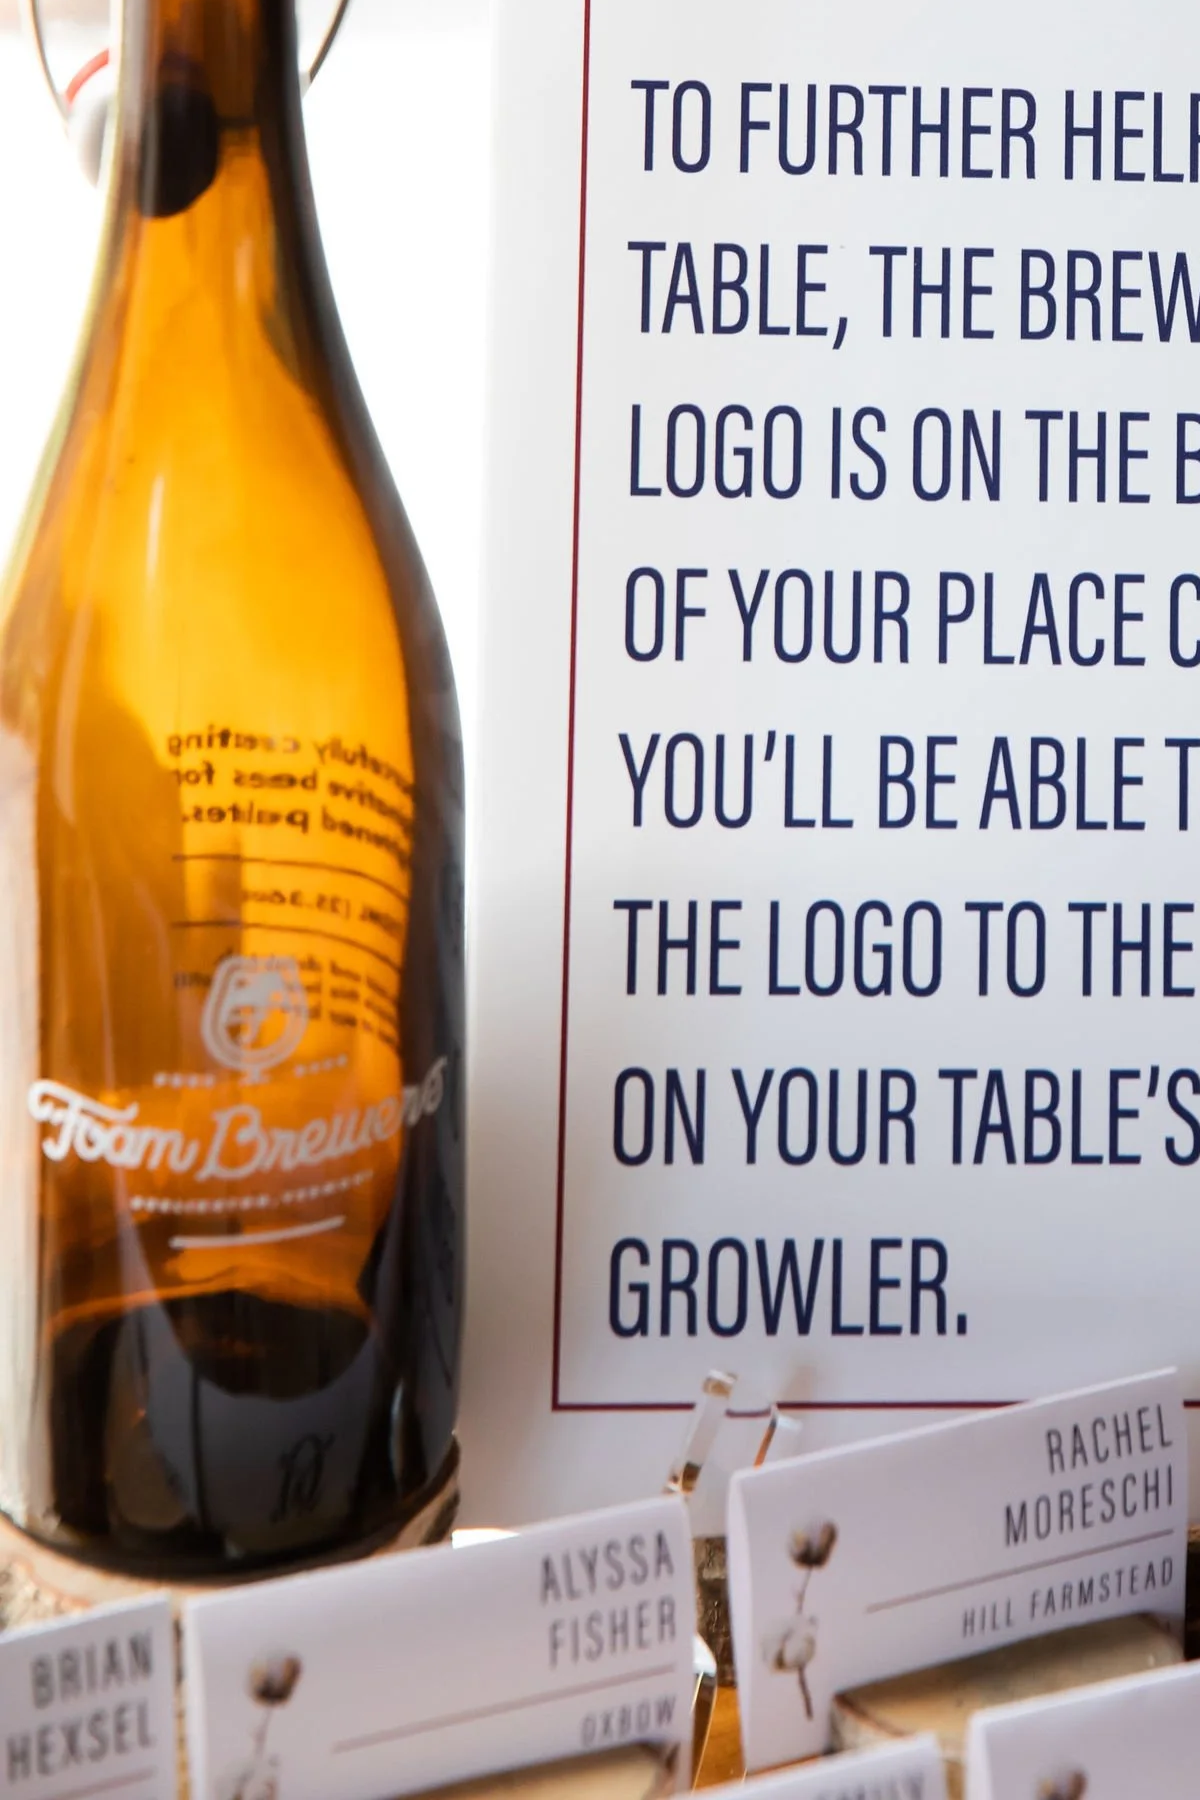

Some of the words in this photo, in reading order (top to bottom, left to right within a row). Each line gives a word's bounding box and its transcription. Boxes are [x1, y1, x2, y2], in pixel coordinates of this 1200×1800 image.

[629, 78, 713, 175] TO
[738, 81, 1038, 181] FURTHER
[626, 240, 849, 351] TABLE,
[868, 244, 996, 341] THE
[629, 402, 804, 501] LOGO
[830, 405, 888, 502] IS
[911, 406, 1002, 503] ON
[1024, 409, 1152, 505] THE
[623, 565, 709, 663] OF
[726, 567, 911, 665] YOUR
[937, 570, 1147, 668] PLACE
[617, 729, 855, 830] YOU'LL
[877, 734, 959, 830] BE
[978, 735, 1147, 832] ABLE
[612, 898, 744, 997] THE
[767, 898, 944, 999] LOGO
[963, 899, 1047, 999] TO
[1066, 900, 1197, 999] THE
[27, 1079, 200, 1174] Foam
[195, 1055, 449, 1182] Brewers
[611, 1065, 707, 1168] ON
[730, 1065, 918, 1167] YOUR
[607, 1235, 969, 1340] GROWLER.
[1045, 1403, 1173, 1475] RACHEL
[1004, 1463, 1173, 1548] MORESCHI
[539, 1530, 675, 1606] ALYSSA
[961, 1596, 1015, 1638] HILL
[1029, 1556, 1174, 1620] FARMSTEAD
[31, 1628, 153, 1710] BRIAN
[549, 1594, 677, 1669] FISHER
[6, 1699, 155, 1786] HEXSEL
